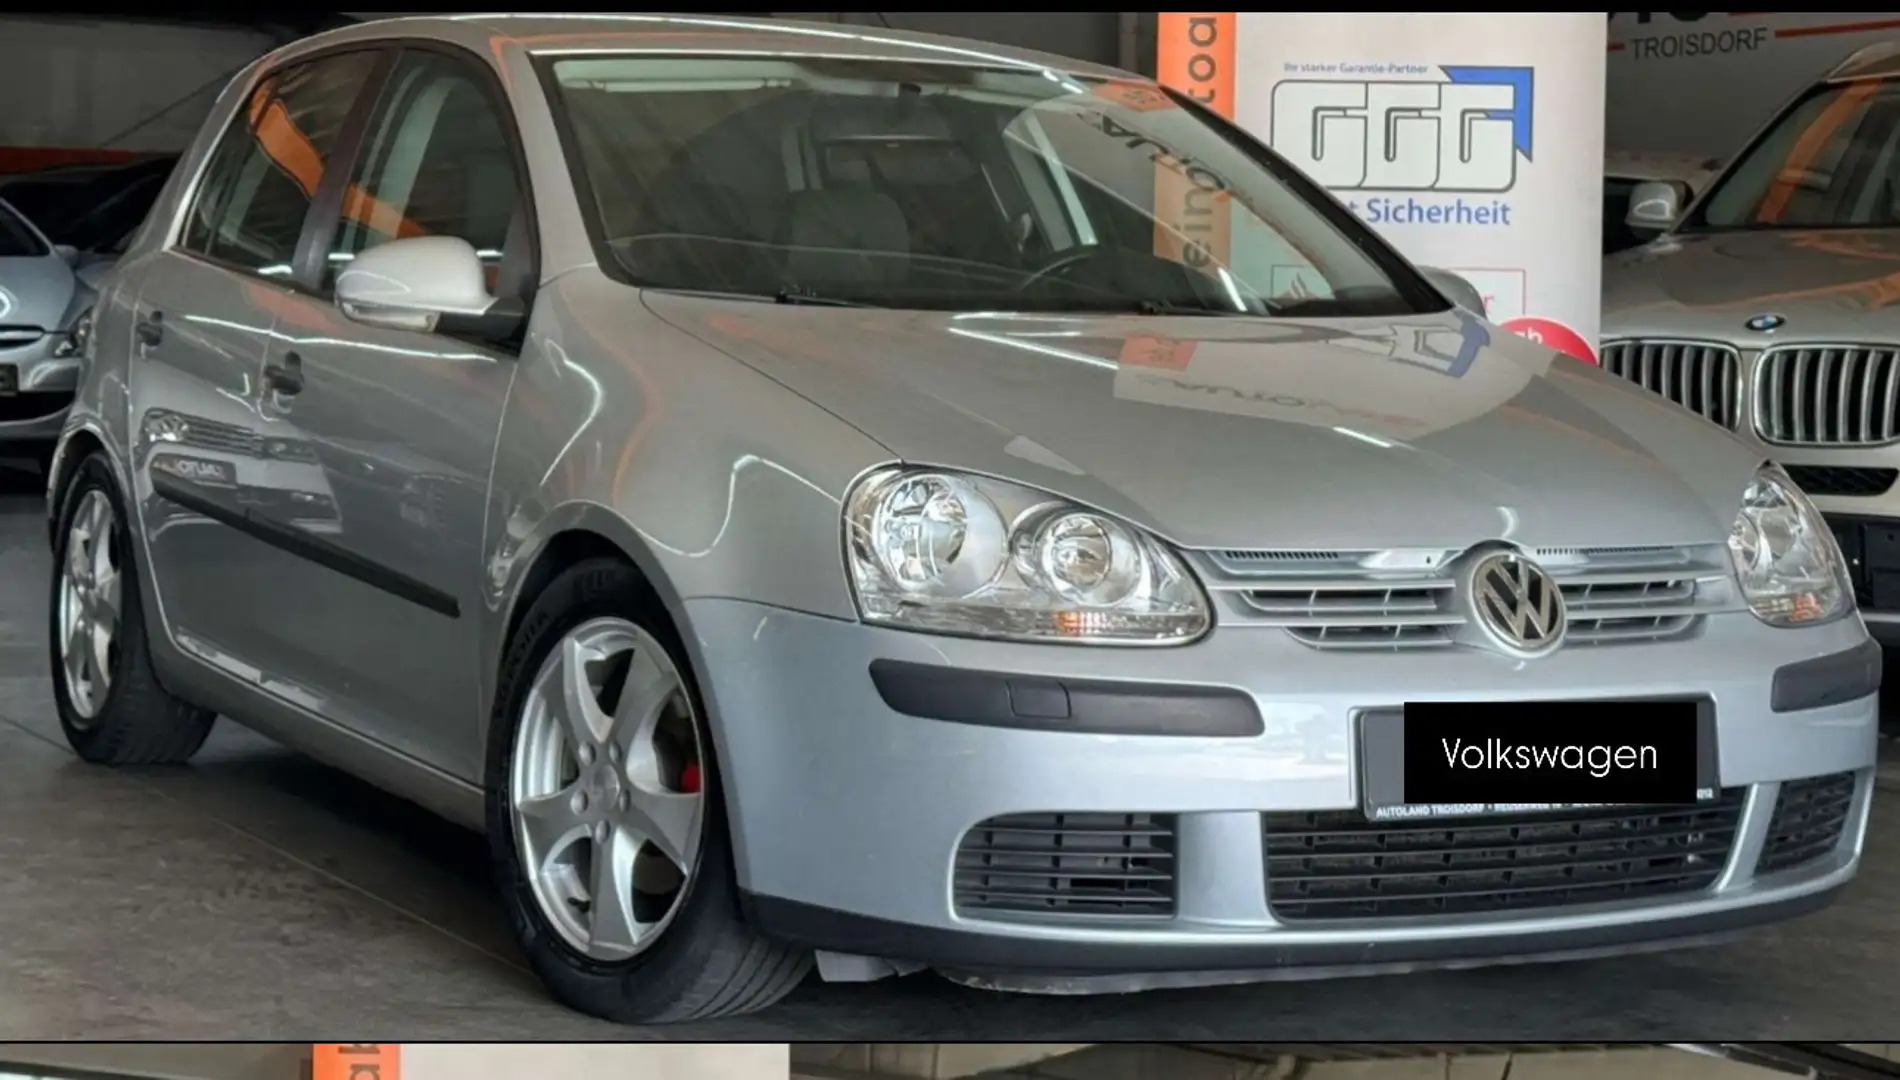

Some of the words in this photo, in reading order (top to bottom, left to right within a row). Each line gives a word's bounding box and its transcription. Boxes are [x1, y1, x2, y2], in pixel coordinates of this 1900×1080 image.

[1630, 27, 1768, 60] TROISDORF
[1301, 63, 1337, 73] starker
[1339, 63, 1428, 74] Garantie-Partner
[1366, 198, 1511, 225] Sicherheit
[1376, 805, 1430, 818] AUTOLAND
